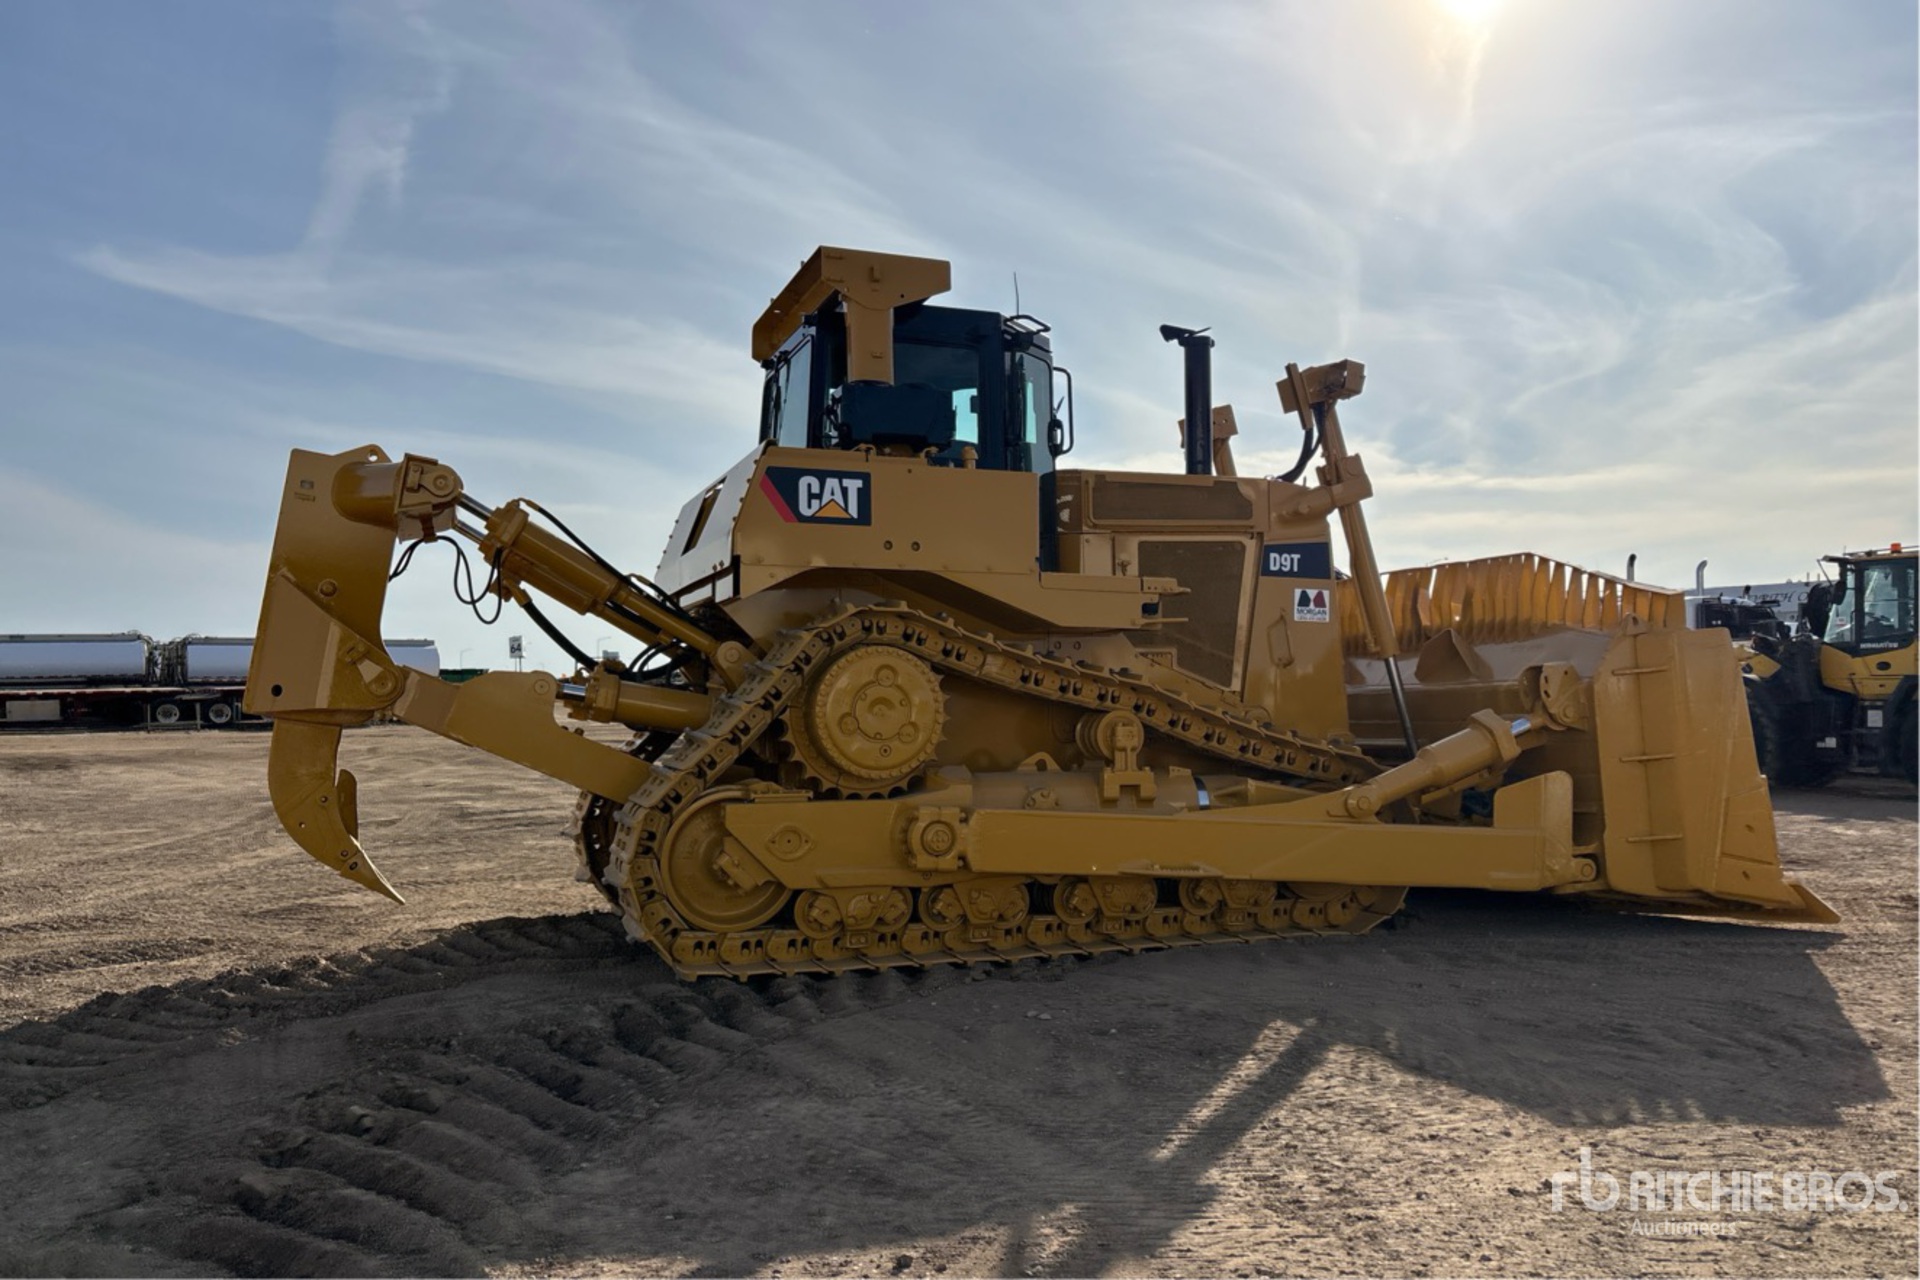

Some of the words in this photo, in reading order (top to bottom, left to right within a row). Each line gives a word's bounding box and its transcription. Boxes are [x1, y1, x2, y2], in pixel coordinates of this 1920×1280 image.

[798, 475, 863, 519] CAT
[1269, 552, 1301, 572] D9T
[1296, 607, 1327, 615] MORGAN
[510, 643, 521, 653] 64
